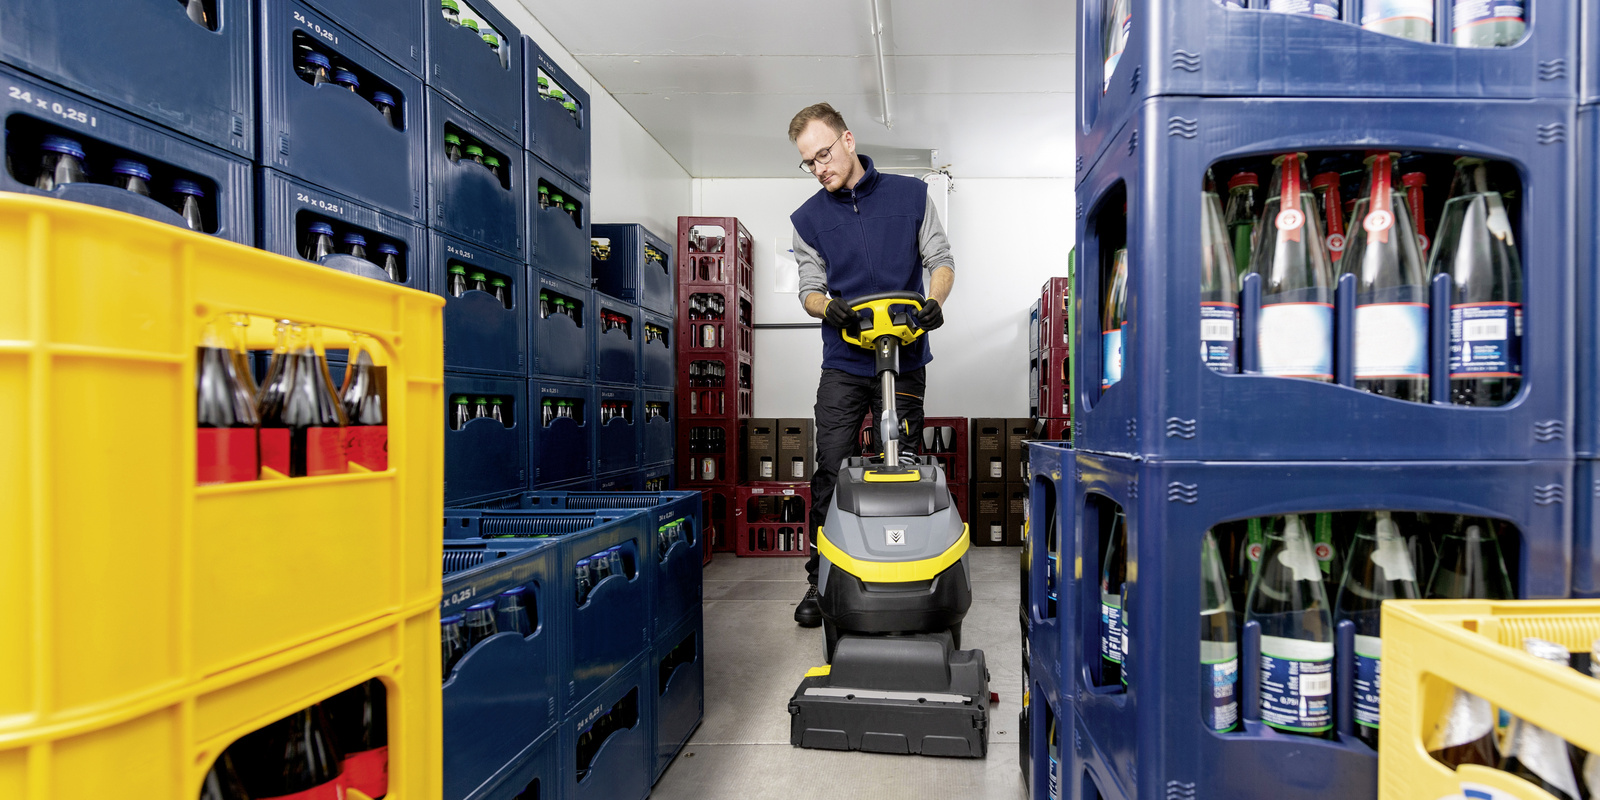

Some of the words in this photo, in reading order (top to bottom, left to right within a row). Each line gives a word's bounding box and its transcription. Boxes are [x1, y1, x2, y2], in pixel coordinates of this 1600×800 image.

[294, 11, 305, 24] 24
[307, 21, 313, 29] x
[315, 24, 333, 41] 0,25
[335, 36, 338, 45] l
[8, 86, 32, 103] 24
[36, 98, 48, 110] x
[52, 102, 87, 124] 0,25
[91, 116, 96, 128] l
[297, 192, 309, 203] 24
[311, 198, 317, 207] x
[319, 200, 338, 213] 0,25
[340, 206, 343, 215] l
[447, 245, 454, 253] 24
[459, 249, 470, 259] 0,25
[443, 598, 450, 608] x
[451, 588, 470, 605] 0,25
[577, 719, 584, 731] 24
[589, 705, 599, 720] 0,25
